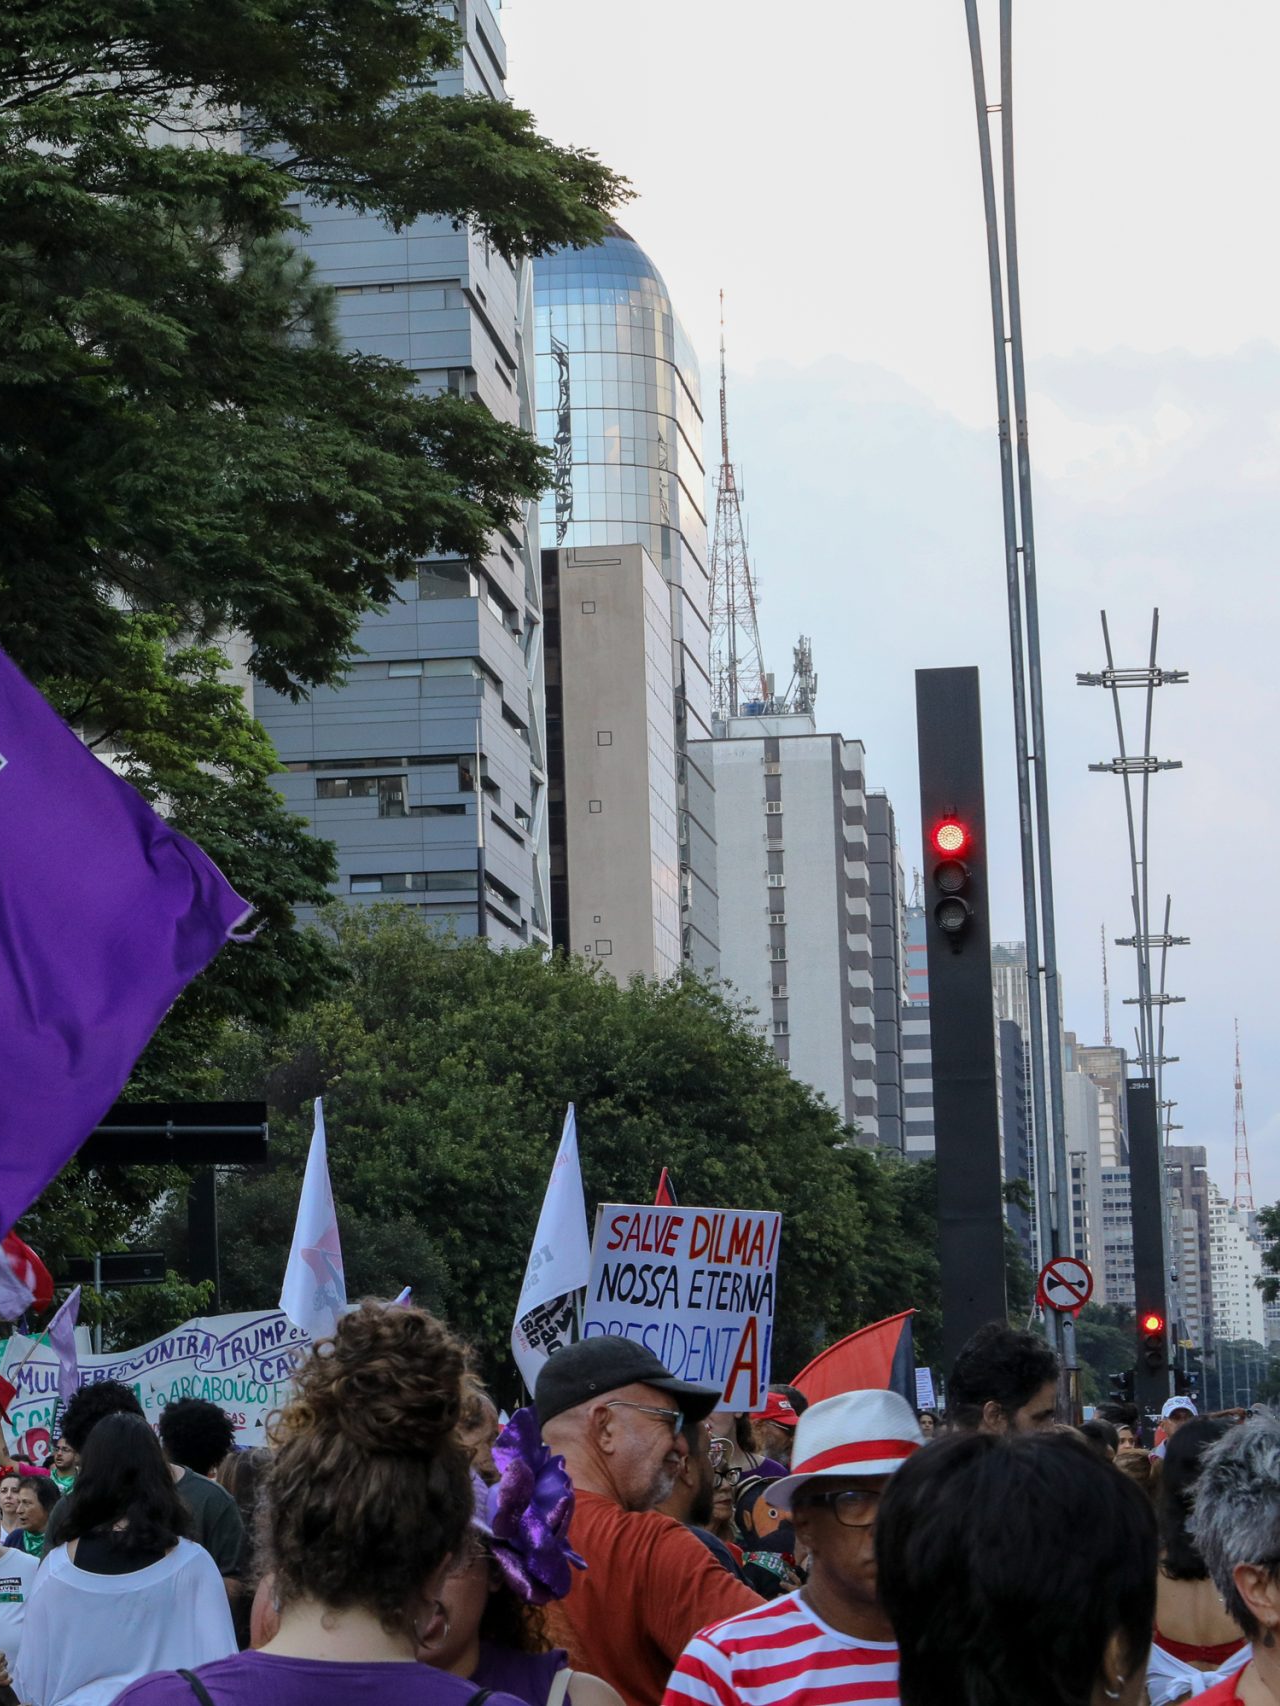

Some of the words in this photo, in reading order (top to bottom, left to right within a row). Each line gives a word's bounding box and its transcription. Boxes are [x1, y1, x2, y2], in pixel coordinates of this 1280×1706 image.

[607, 1212, 684, 1257] SALVE
[689, 1214, 780, 1271] DILMA!
[596, 1263, 679, 1310] NOSSA
[687, 1269, 773, 1317] ETERNA
[216, 1320, 287, 1367] TRUMP
